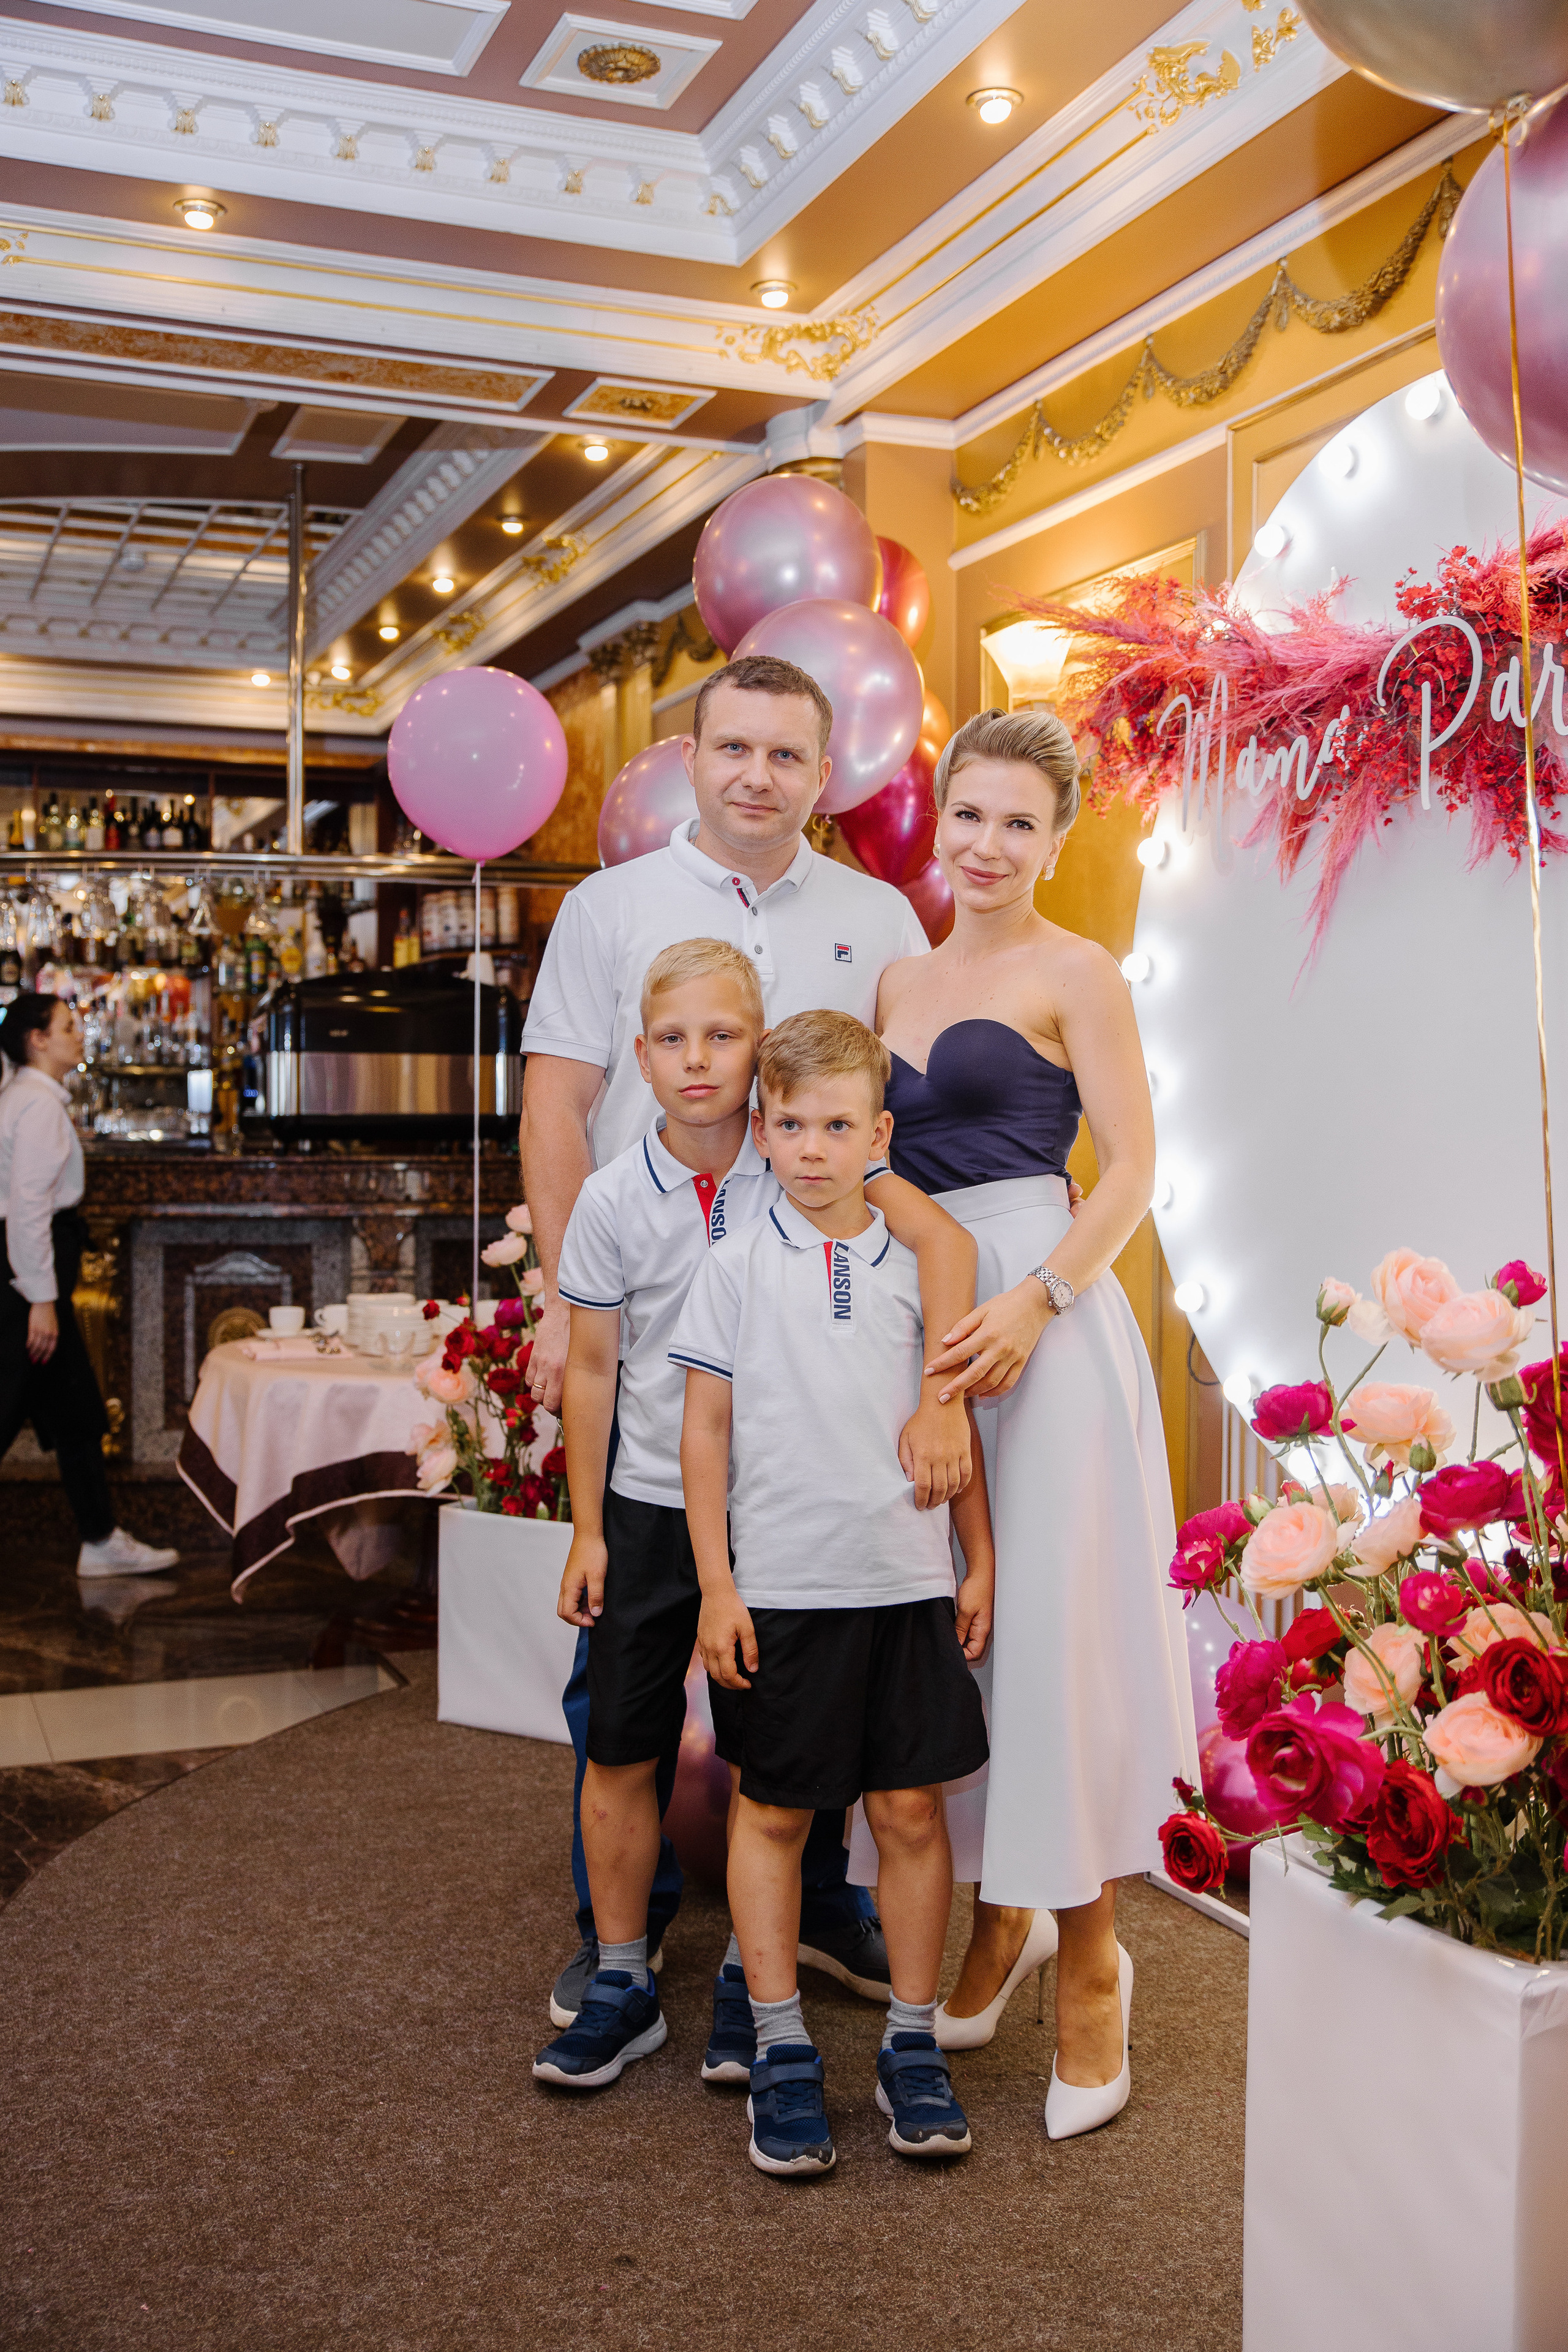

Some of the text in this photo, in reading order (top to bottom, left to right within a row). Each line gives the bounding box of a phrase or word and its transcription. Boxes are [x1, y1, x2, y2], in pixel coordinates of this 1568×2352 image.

[1376, 615, 1568, 810] Par
[710, 1179, 731, 1246] ANSO
[833, 1240, 851, 1320] LANSON
